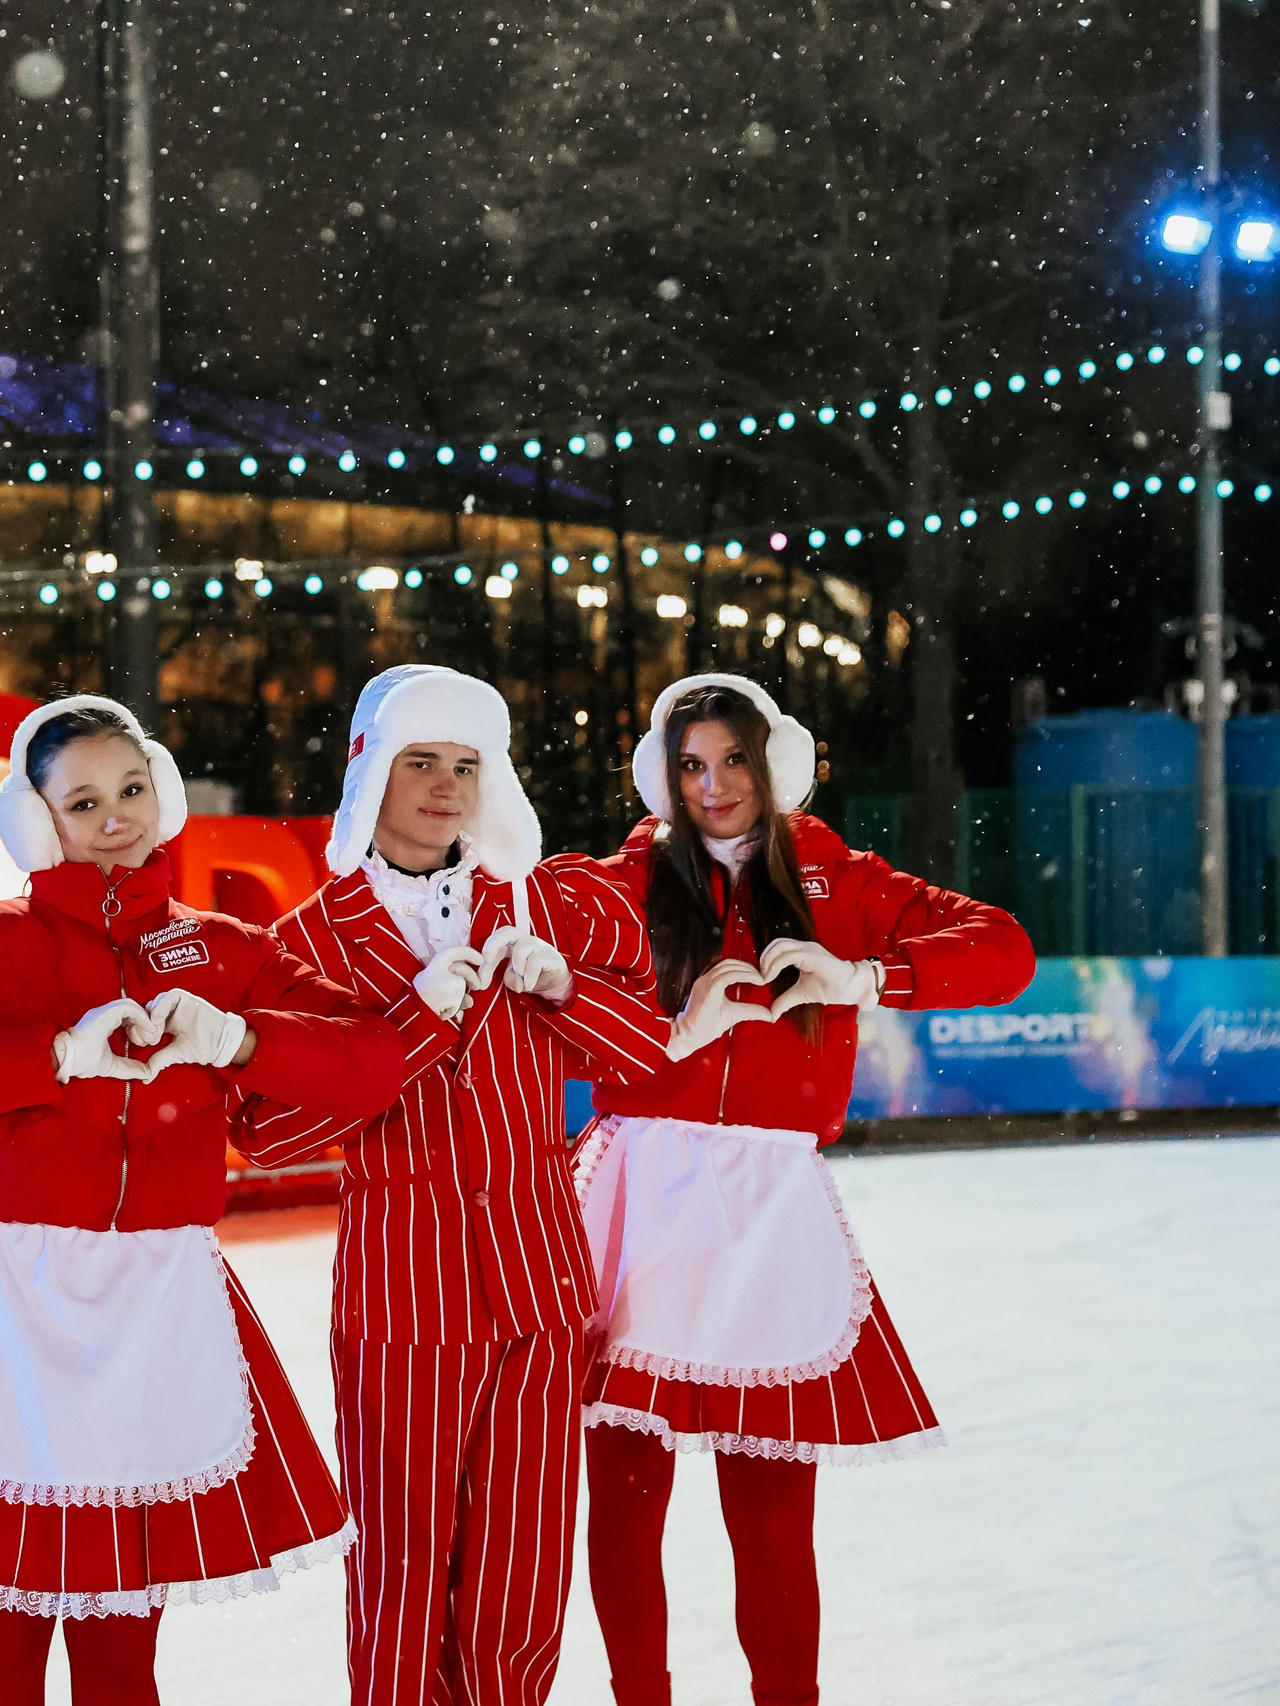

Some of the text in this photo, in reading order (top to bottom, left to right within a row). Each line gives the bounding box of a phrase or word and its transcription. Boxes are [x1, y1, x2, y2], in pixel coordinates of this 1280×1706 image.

[139, 918, 197, 955] Московское
[158, 945, 200, 963] ЗИМА
[170, 954, 202, 967] МОСКВЕ
